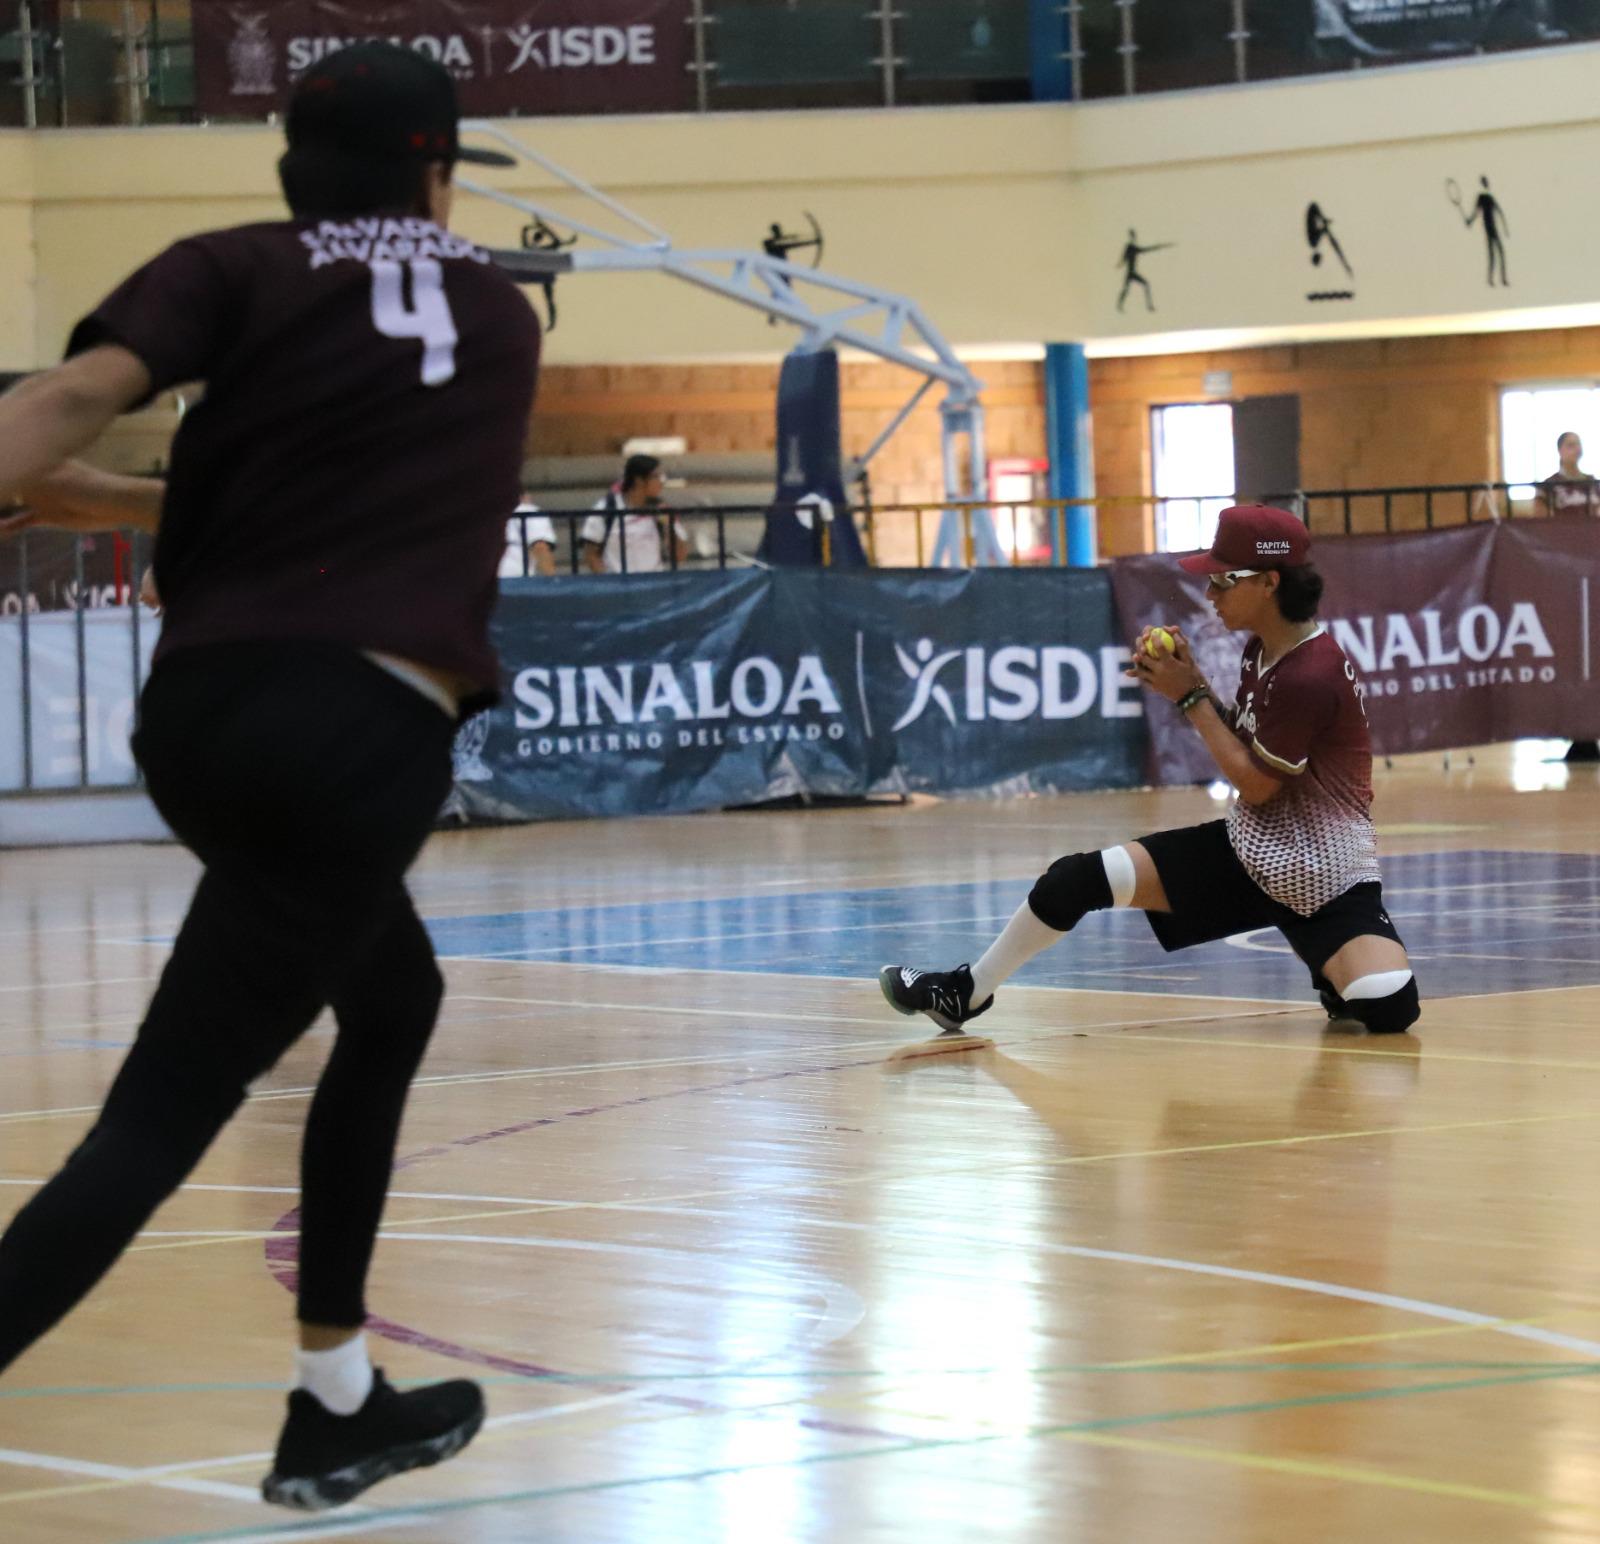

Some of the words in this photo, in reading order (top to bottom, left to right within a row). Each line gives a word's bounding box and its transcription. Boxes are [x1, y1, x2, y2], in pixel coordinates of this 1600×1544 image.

[288, 35, 472, 70] SIOA
[548, 26, 656, 66] ISDE
[368, 259, 458, 386] 4
[1256, 540, 1290, 549] CAPITAL
[1316, 603, 1555, 673] NALOA
[513, 656, 842, 730] SINALOA
[966, 646, 1143, 721] ISDE
[1411, 674, 1455, 693] DEL
[1467, 666, 1556, 687] ESTADO
[518, 732, 663, 757] GOBIERNO
[678, 729, 724, 748] DEL
[737, 723, 845, 744] ESTADO
